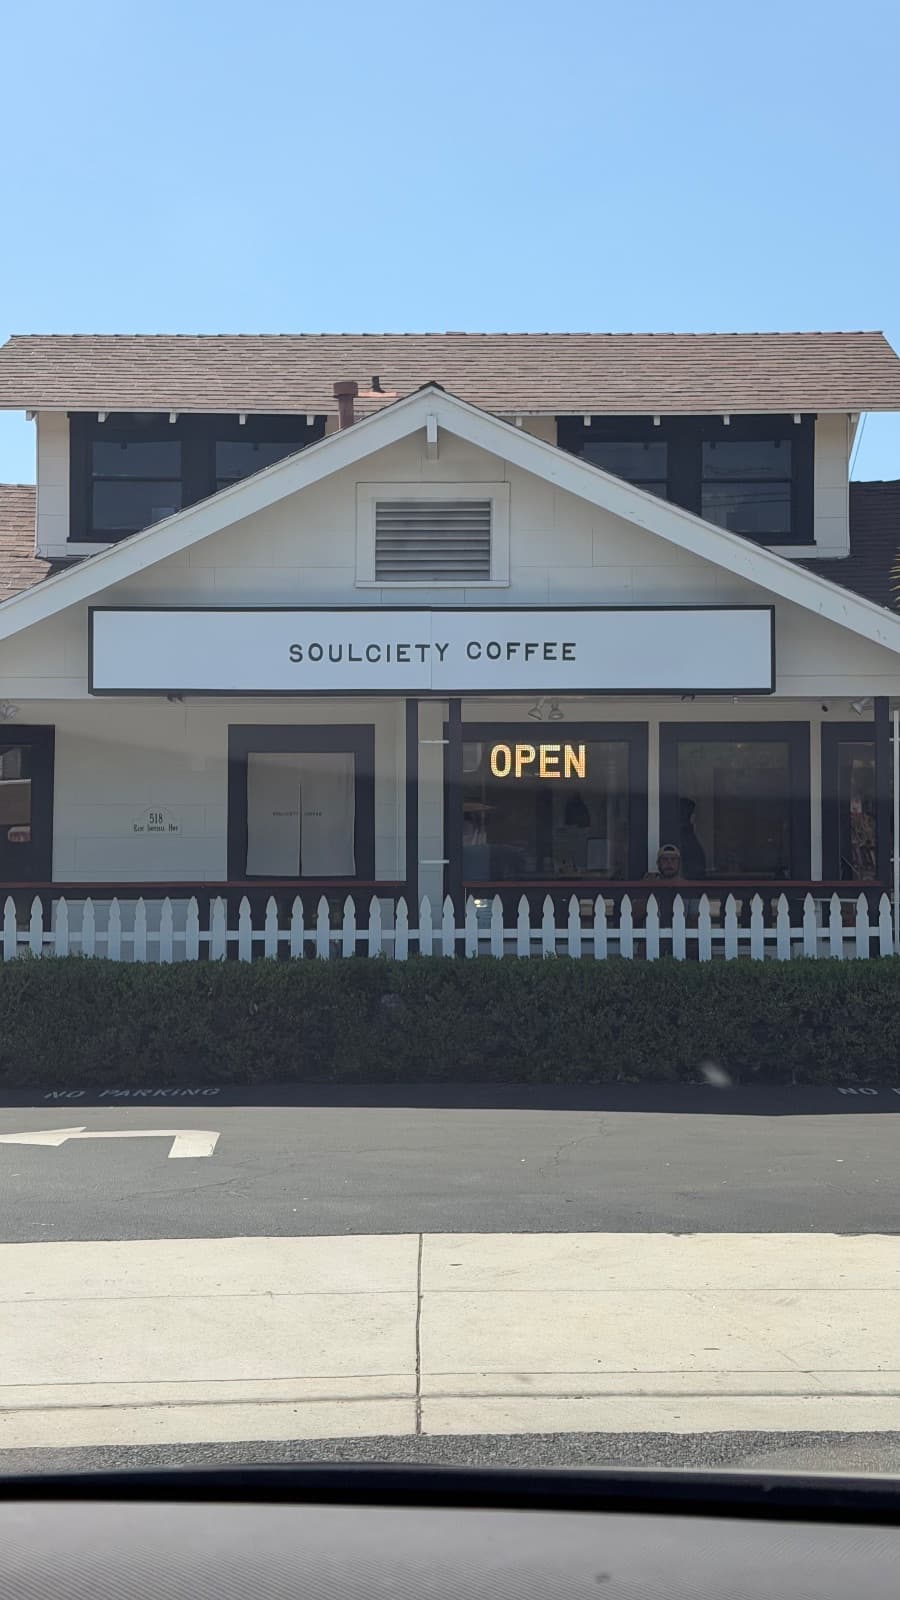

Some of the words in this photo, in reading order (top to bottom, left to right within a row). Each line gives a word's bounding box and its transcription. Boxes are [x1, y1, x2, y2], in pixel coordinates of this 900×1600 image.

[289, 643, 450, 663] SOULCIETY
[466, 641, 577, 661] COFFEE
[490, 744, 587, 779] OPEN
[149, 812, 164, 824] 518
[44, 1090, 86, 1099] NO
[98, 1087, 221, 1097] PARKING
[837, 1087, 878, 1095] NO
